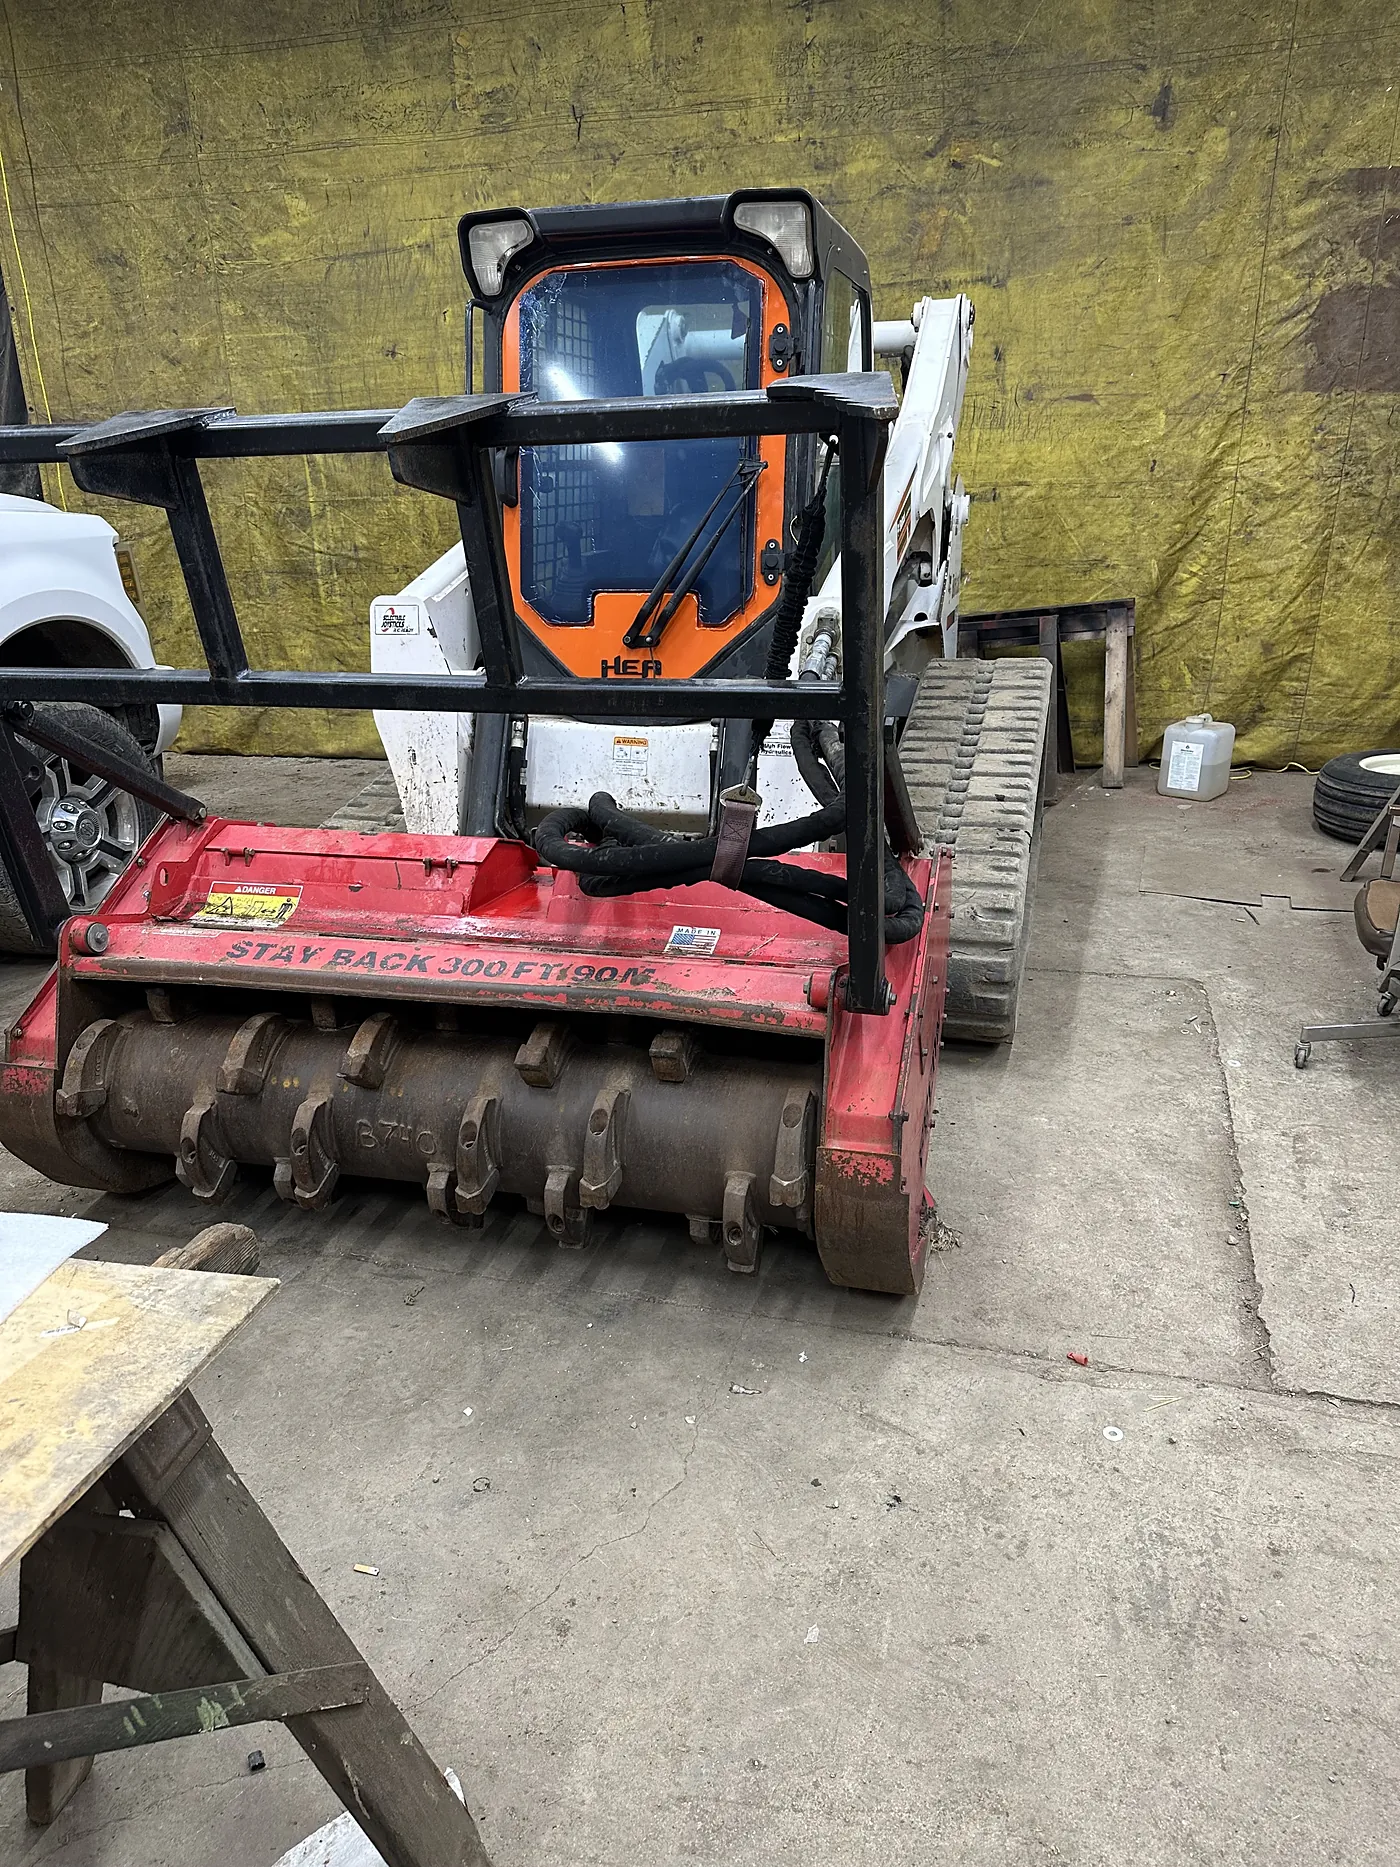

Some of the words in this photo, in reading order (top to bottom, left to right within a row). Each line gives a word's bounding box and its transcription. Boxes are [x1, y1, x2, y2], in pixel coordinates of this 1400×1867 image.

[241, 885, 277, 895] DANGER
[675, 927, 703, 935] MADE
[226, 940, 325, 964] STAY
[328, 948, 435, 973] BACK
[437, 957, 508, 978] 300
